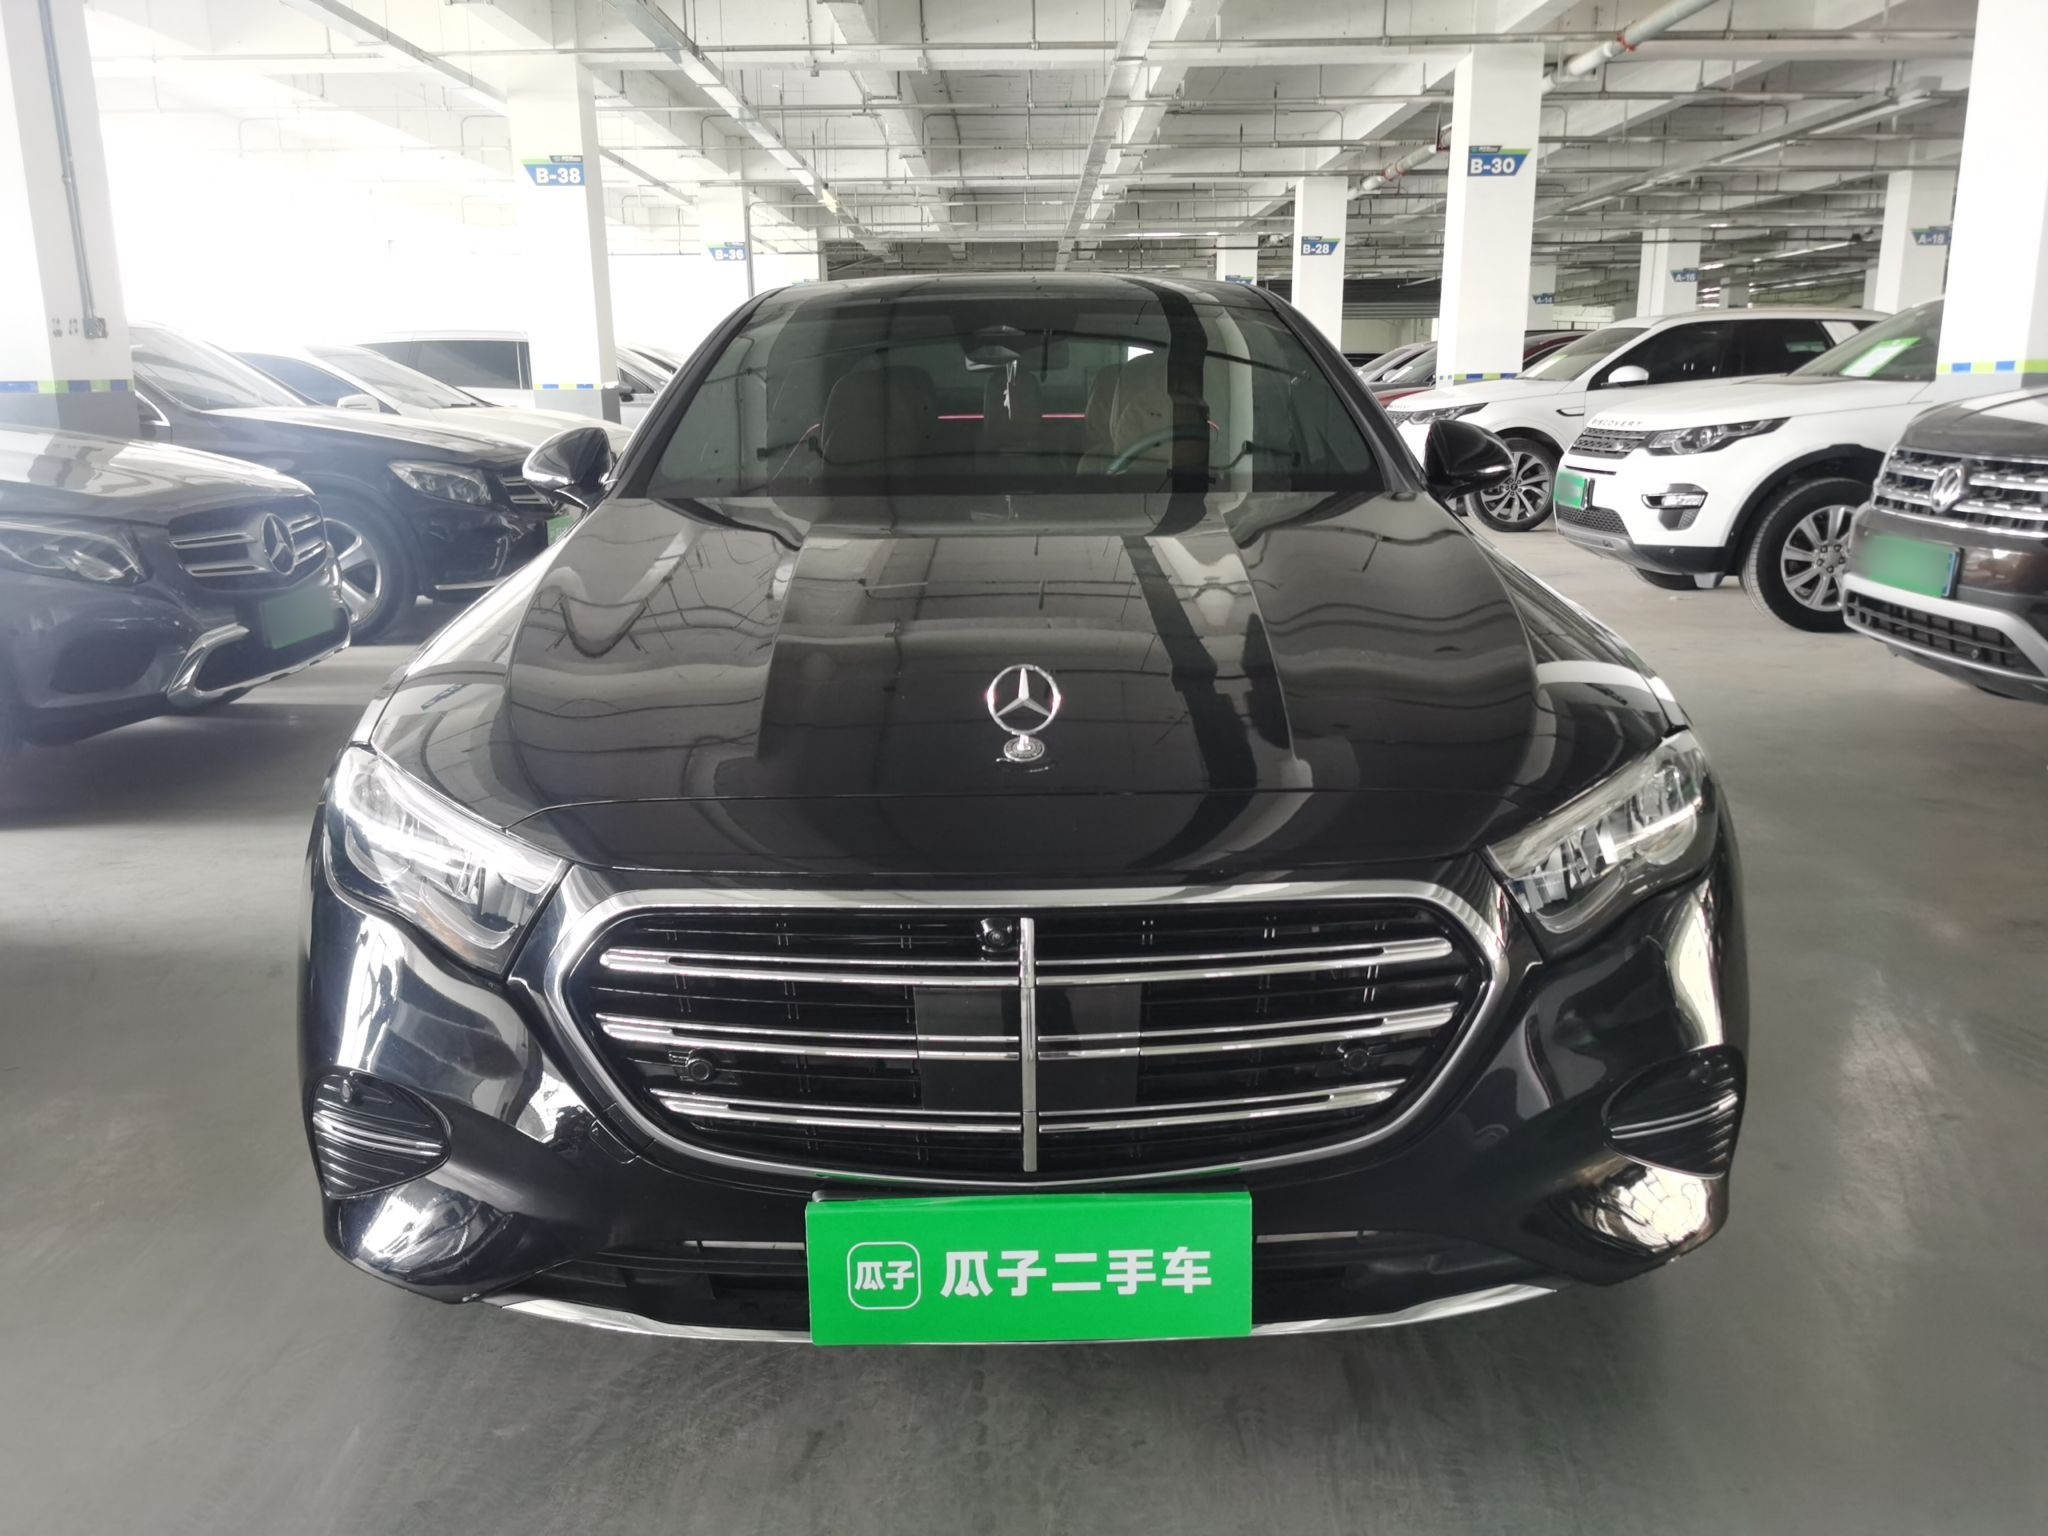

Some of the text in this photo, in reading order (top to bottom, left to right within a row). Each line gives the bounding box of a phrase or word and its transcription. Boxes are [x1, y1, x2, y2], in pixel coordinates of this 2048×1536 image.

[1470, 157, 1516, 174] B-30
[535, 167, 581, 184] B-38
[714, 249, 744, 260] B-36
[1302, 243, 1330, 254] B-28
[1591, 417, 1644, 428] DISCOVERY
[854, 1260, 915, 1290] 瓜子
[940, 1246, 1212, 1298] 瓜子二手车
